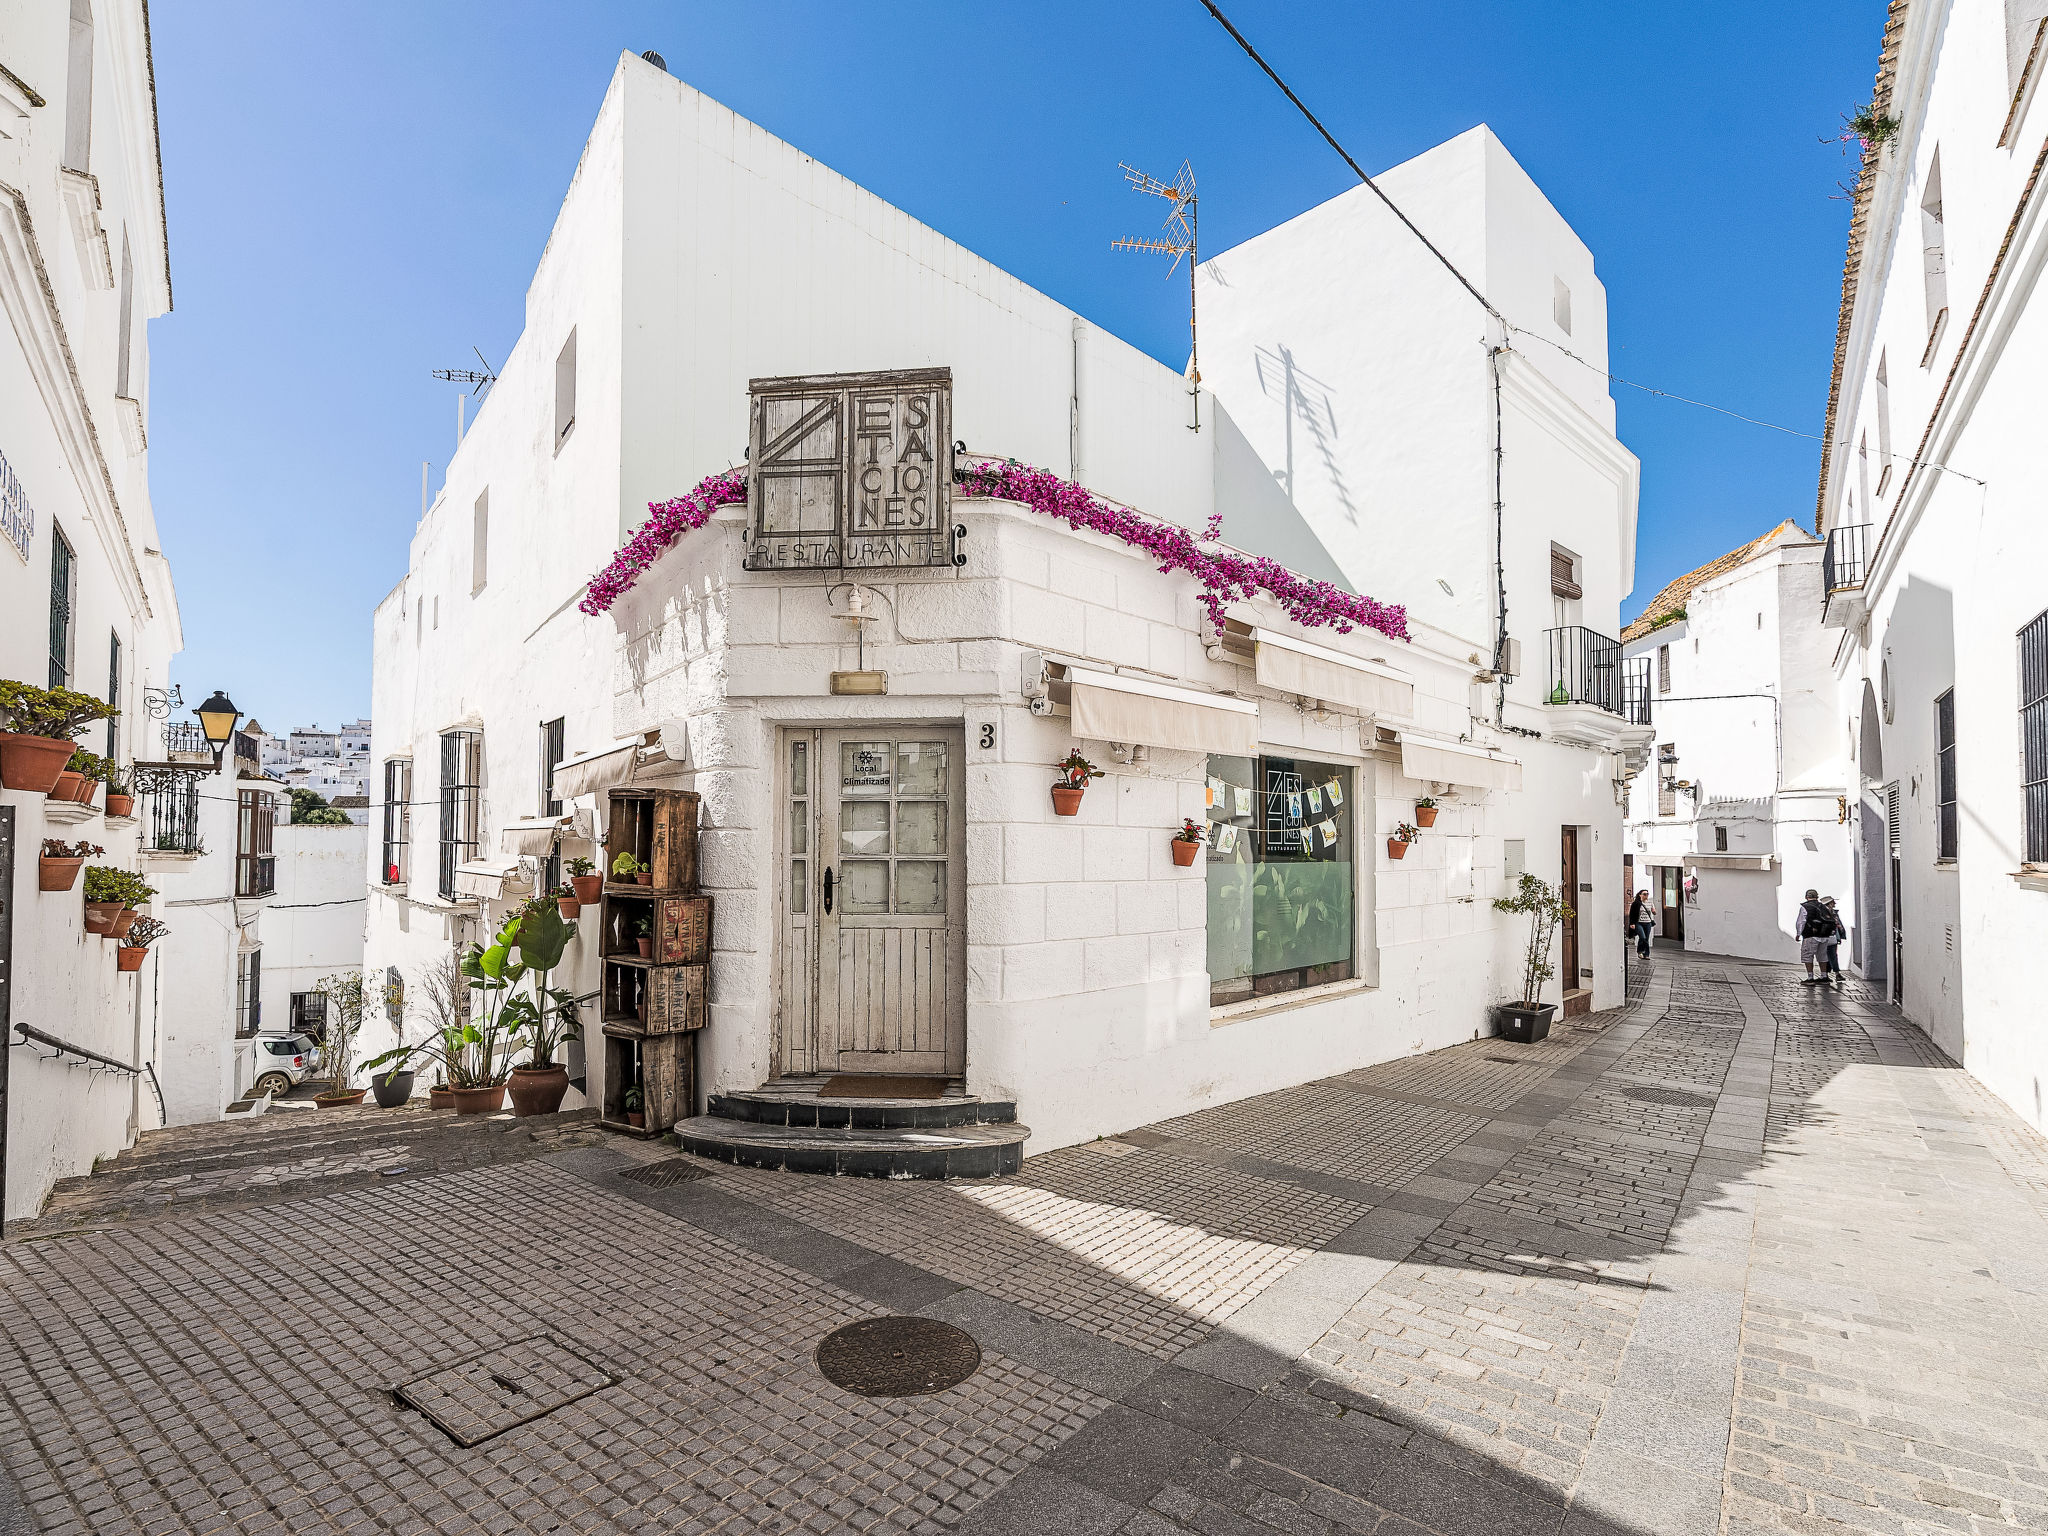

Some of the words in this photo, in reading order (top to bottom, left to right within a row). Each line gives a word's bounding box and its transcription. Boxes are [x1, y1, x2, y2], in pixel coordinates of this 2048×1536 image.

[756, 541, 944, 562] RESTAURANTE
[980, 723, 995, 749] 3
[855, 764, 877, 772] Local
[843, 777, 890, 786] Climatizado
